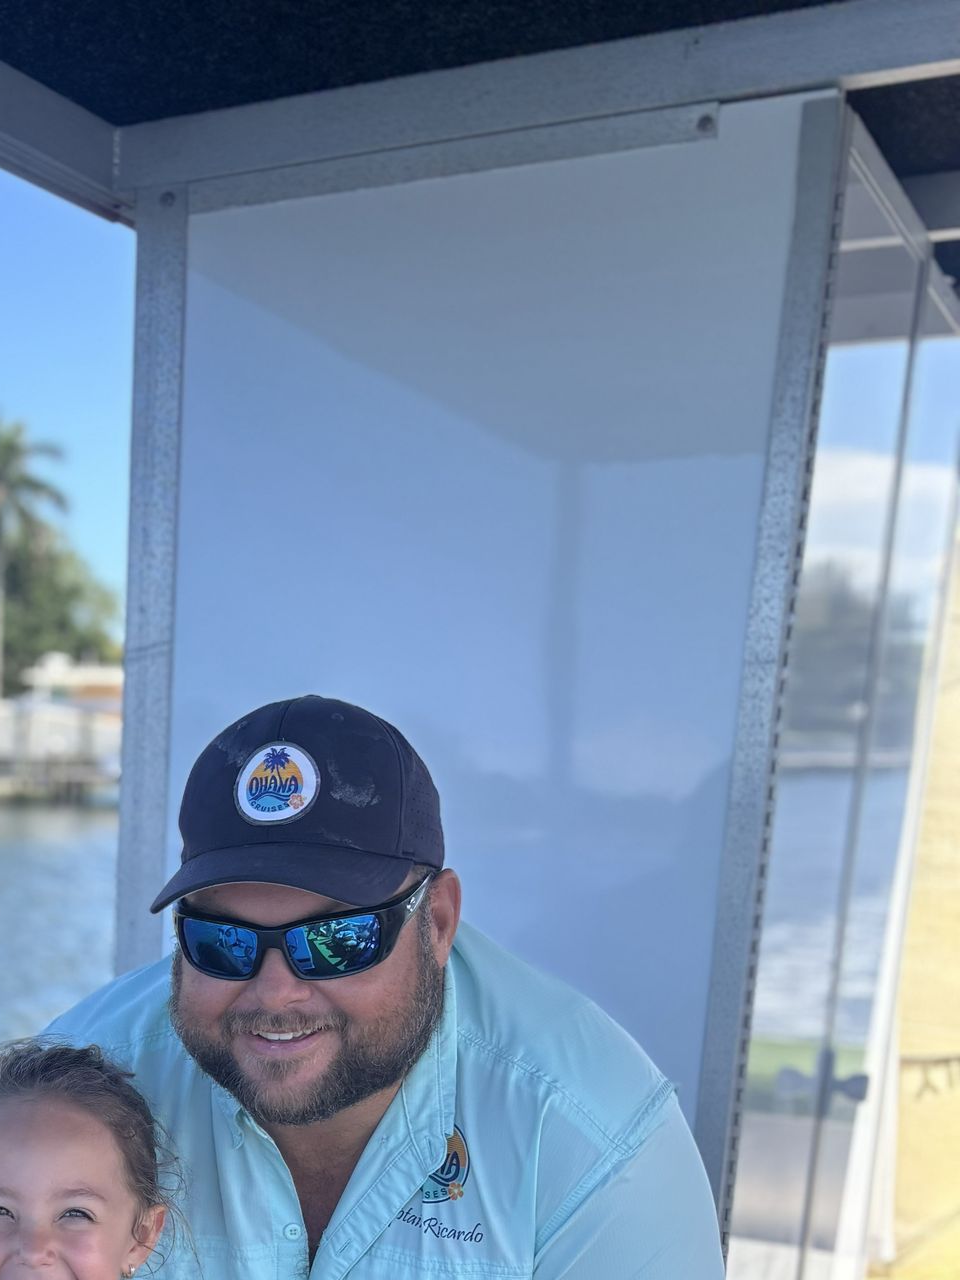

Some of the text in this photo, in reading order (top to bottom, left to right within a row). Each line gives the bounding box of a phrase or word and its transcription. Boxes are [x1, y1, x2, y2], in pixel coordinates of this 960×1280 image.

[248, 775, 299, 797] OHANA
[250, 800, 290, 812] CRUISES
[423, 1217, 484, 1243] Ricardo
